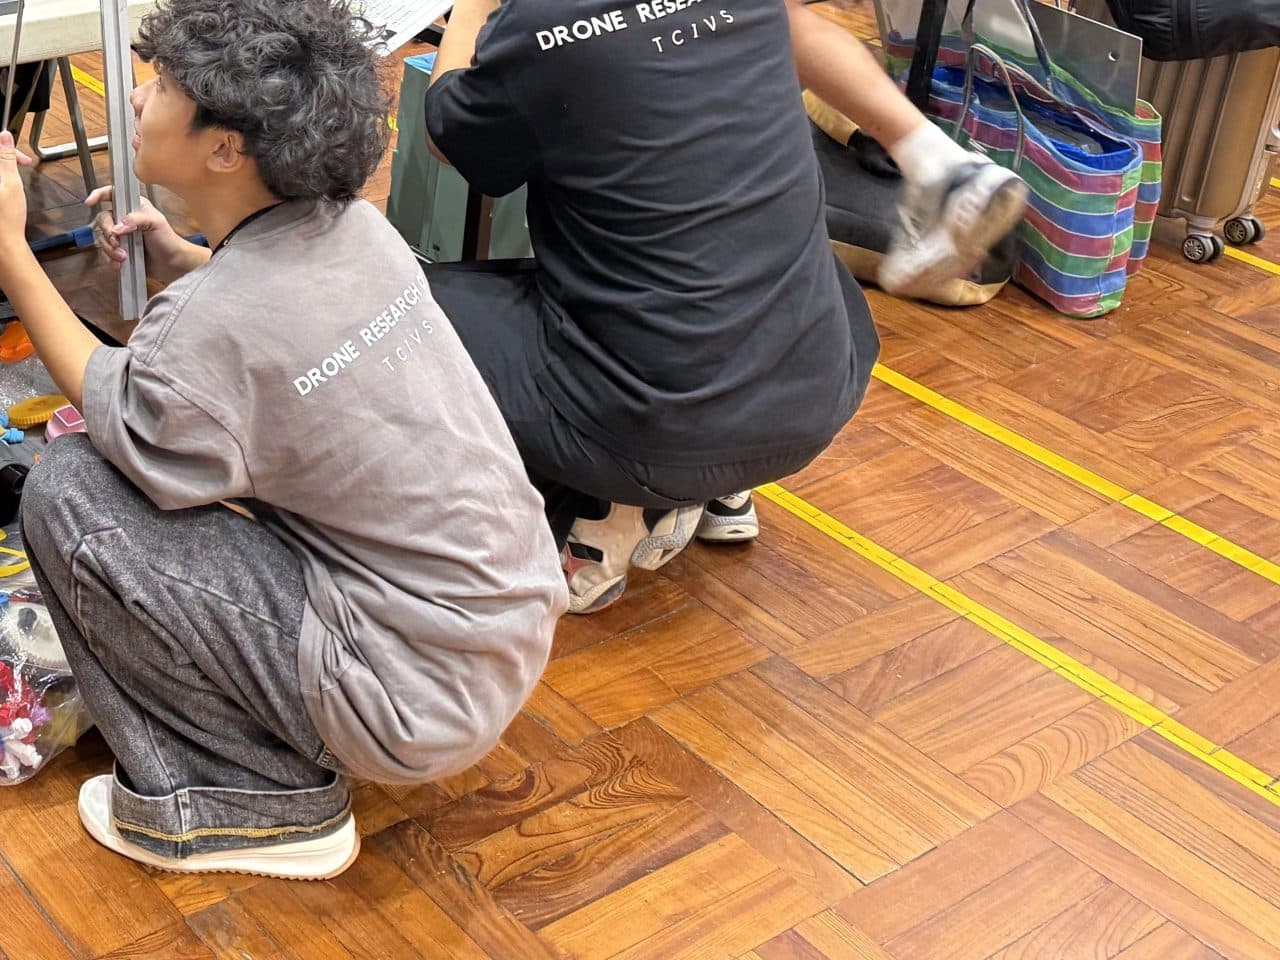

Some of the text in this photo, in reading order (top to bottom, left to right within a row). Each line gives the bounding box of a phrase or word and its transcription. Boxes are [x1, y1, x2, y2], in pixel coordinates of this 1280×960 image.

[535, 9, 628, 51] DRONE
[292, 282, 423, 397] DRONE RESEARCH
